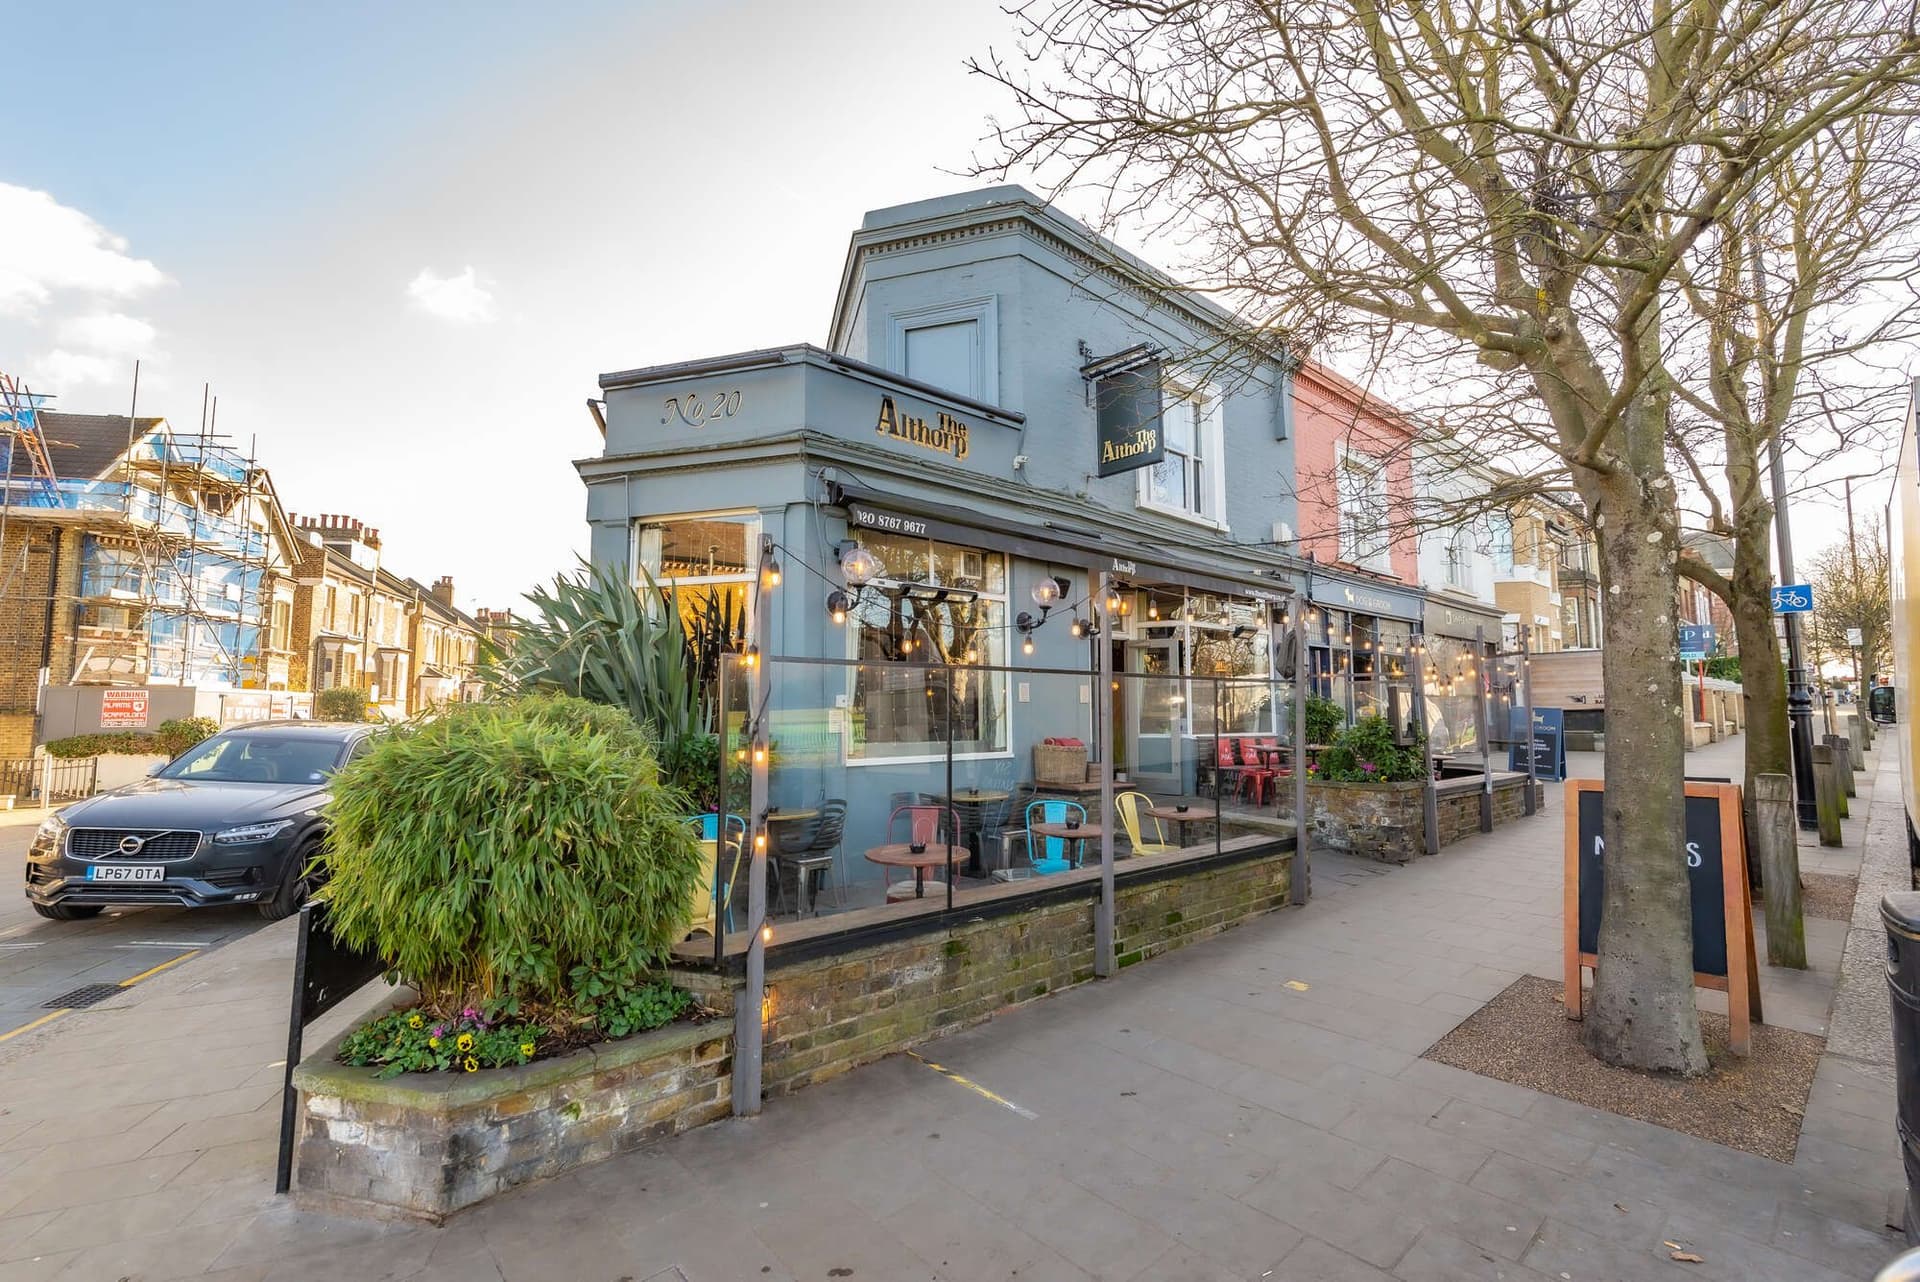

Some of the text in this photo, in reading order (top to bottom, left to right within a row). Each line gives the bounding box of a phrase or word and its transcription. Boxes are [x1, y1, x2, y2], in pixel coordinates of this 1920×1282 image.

[710, 390, 743, 420] 20
[875, 393, 969, 462] Althorp
[936, 411, 968, 437] The
[1135, 429, 1156, 443] The
[1102, 440, 1157, 464] Althorp
[878, 514, 901, 530] 8767
[903, 520, 926, 534] 9677
[95, 868, 161, 880] LP67 OTA
